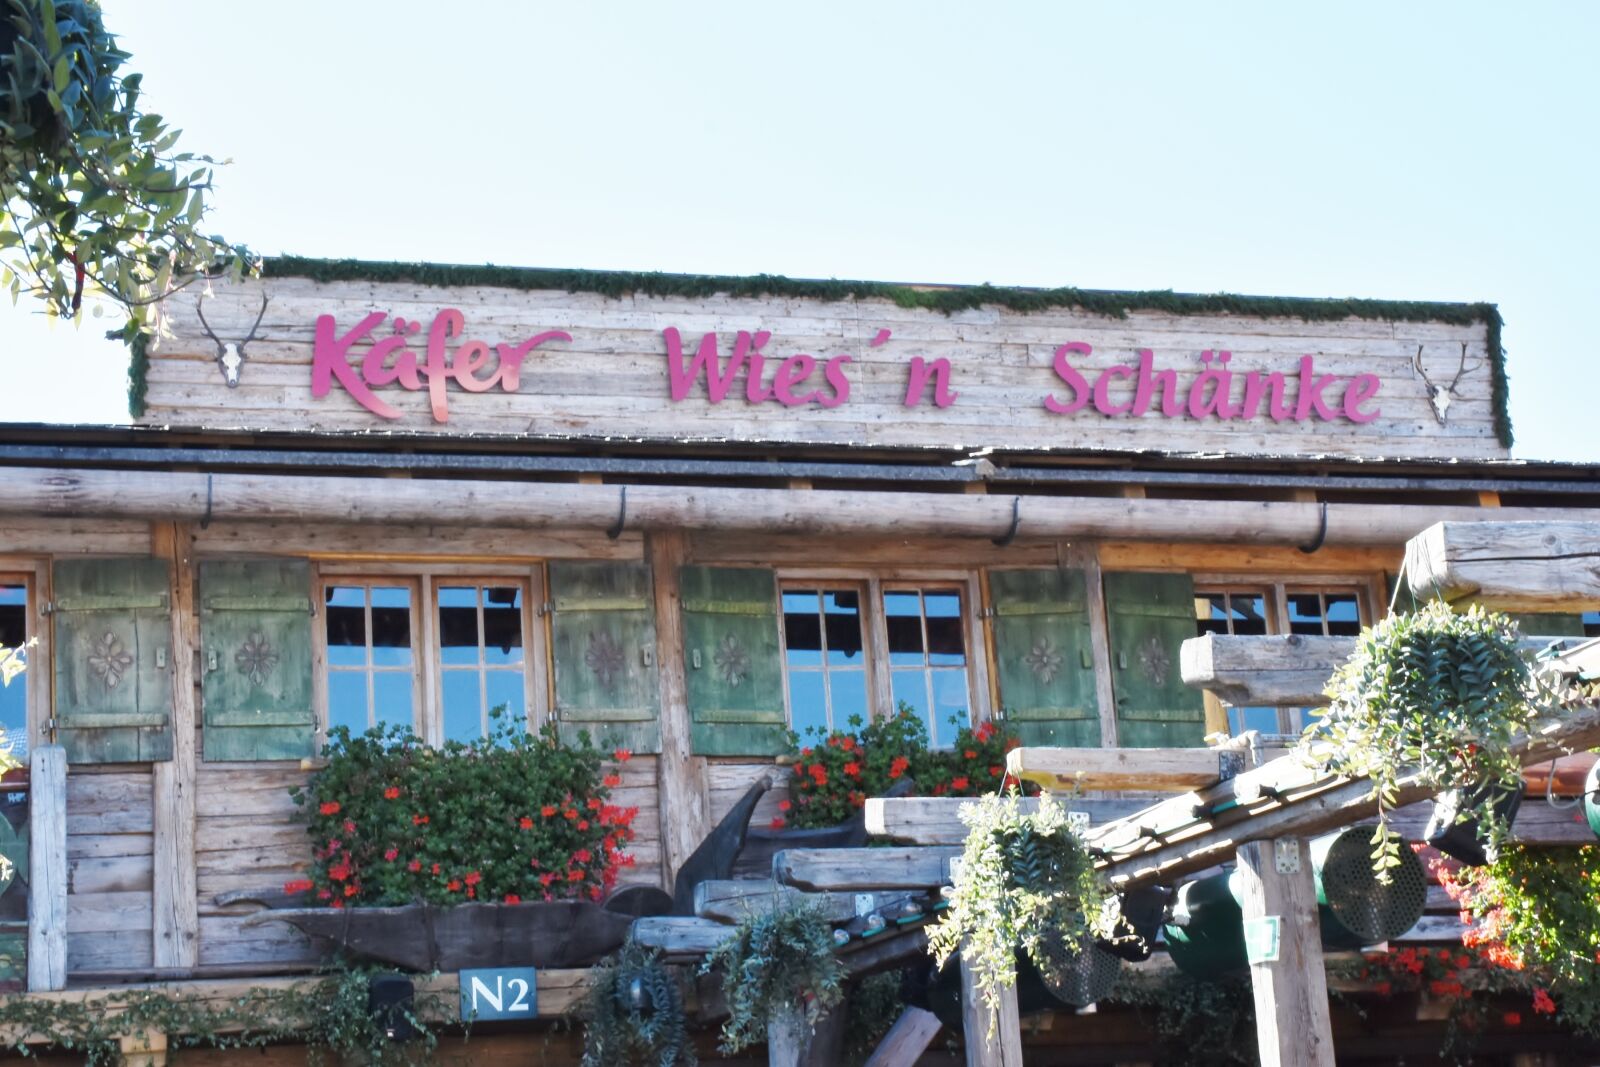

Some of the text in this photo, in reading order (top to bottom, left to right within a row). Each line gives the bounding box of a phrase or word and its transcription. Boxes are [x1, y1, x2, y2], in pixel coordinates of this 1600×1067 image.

[311, 308, 573, 423] Käfer
[1044, 341, 1381, 423] Schänke
[471, 975, 529, 1013] N2
